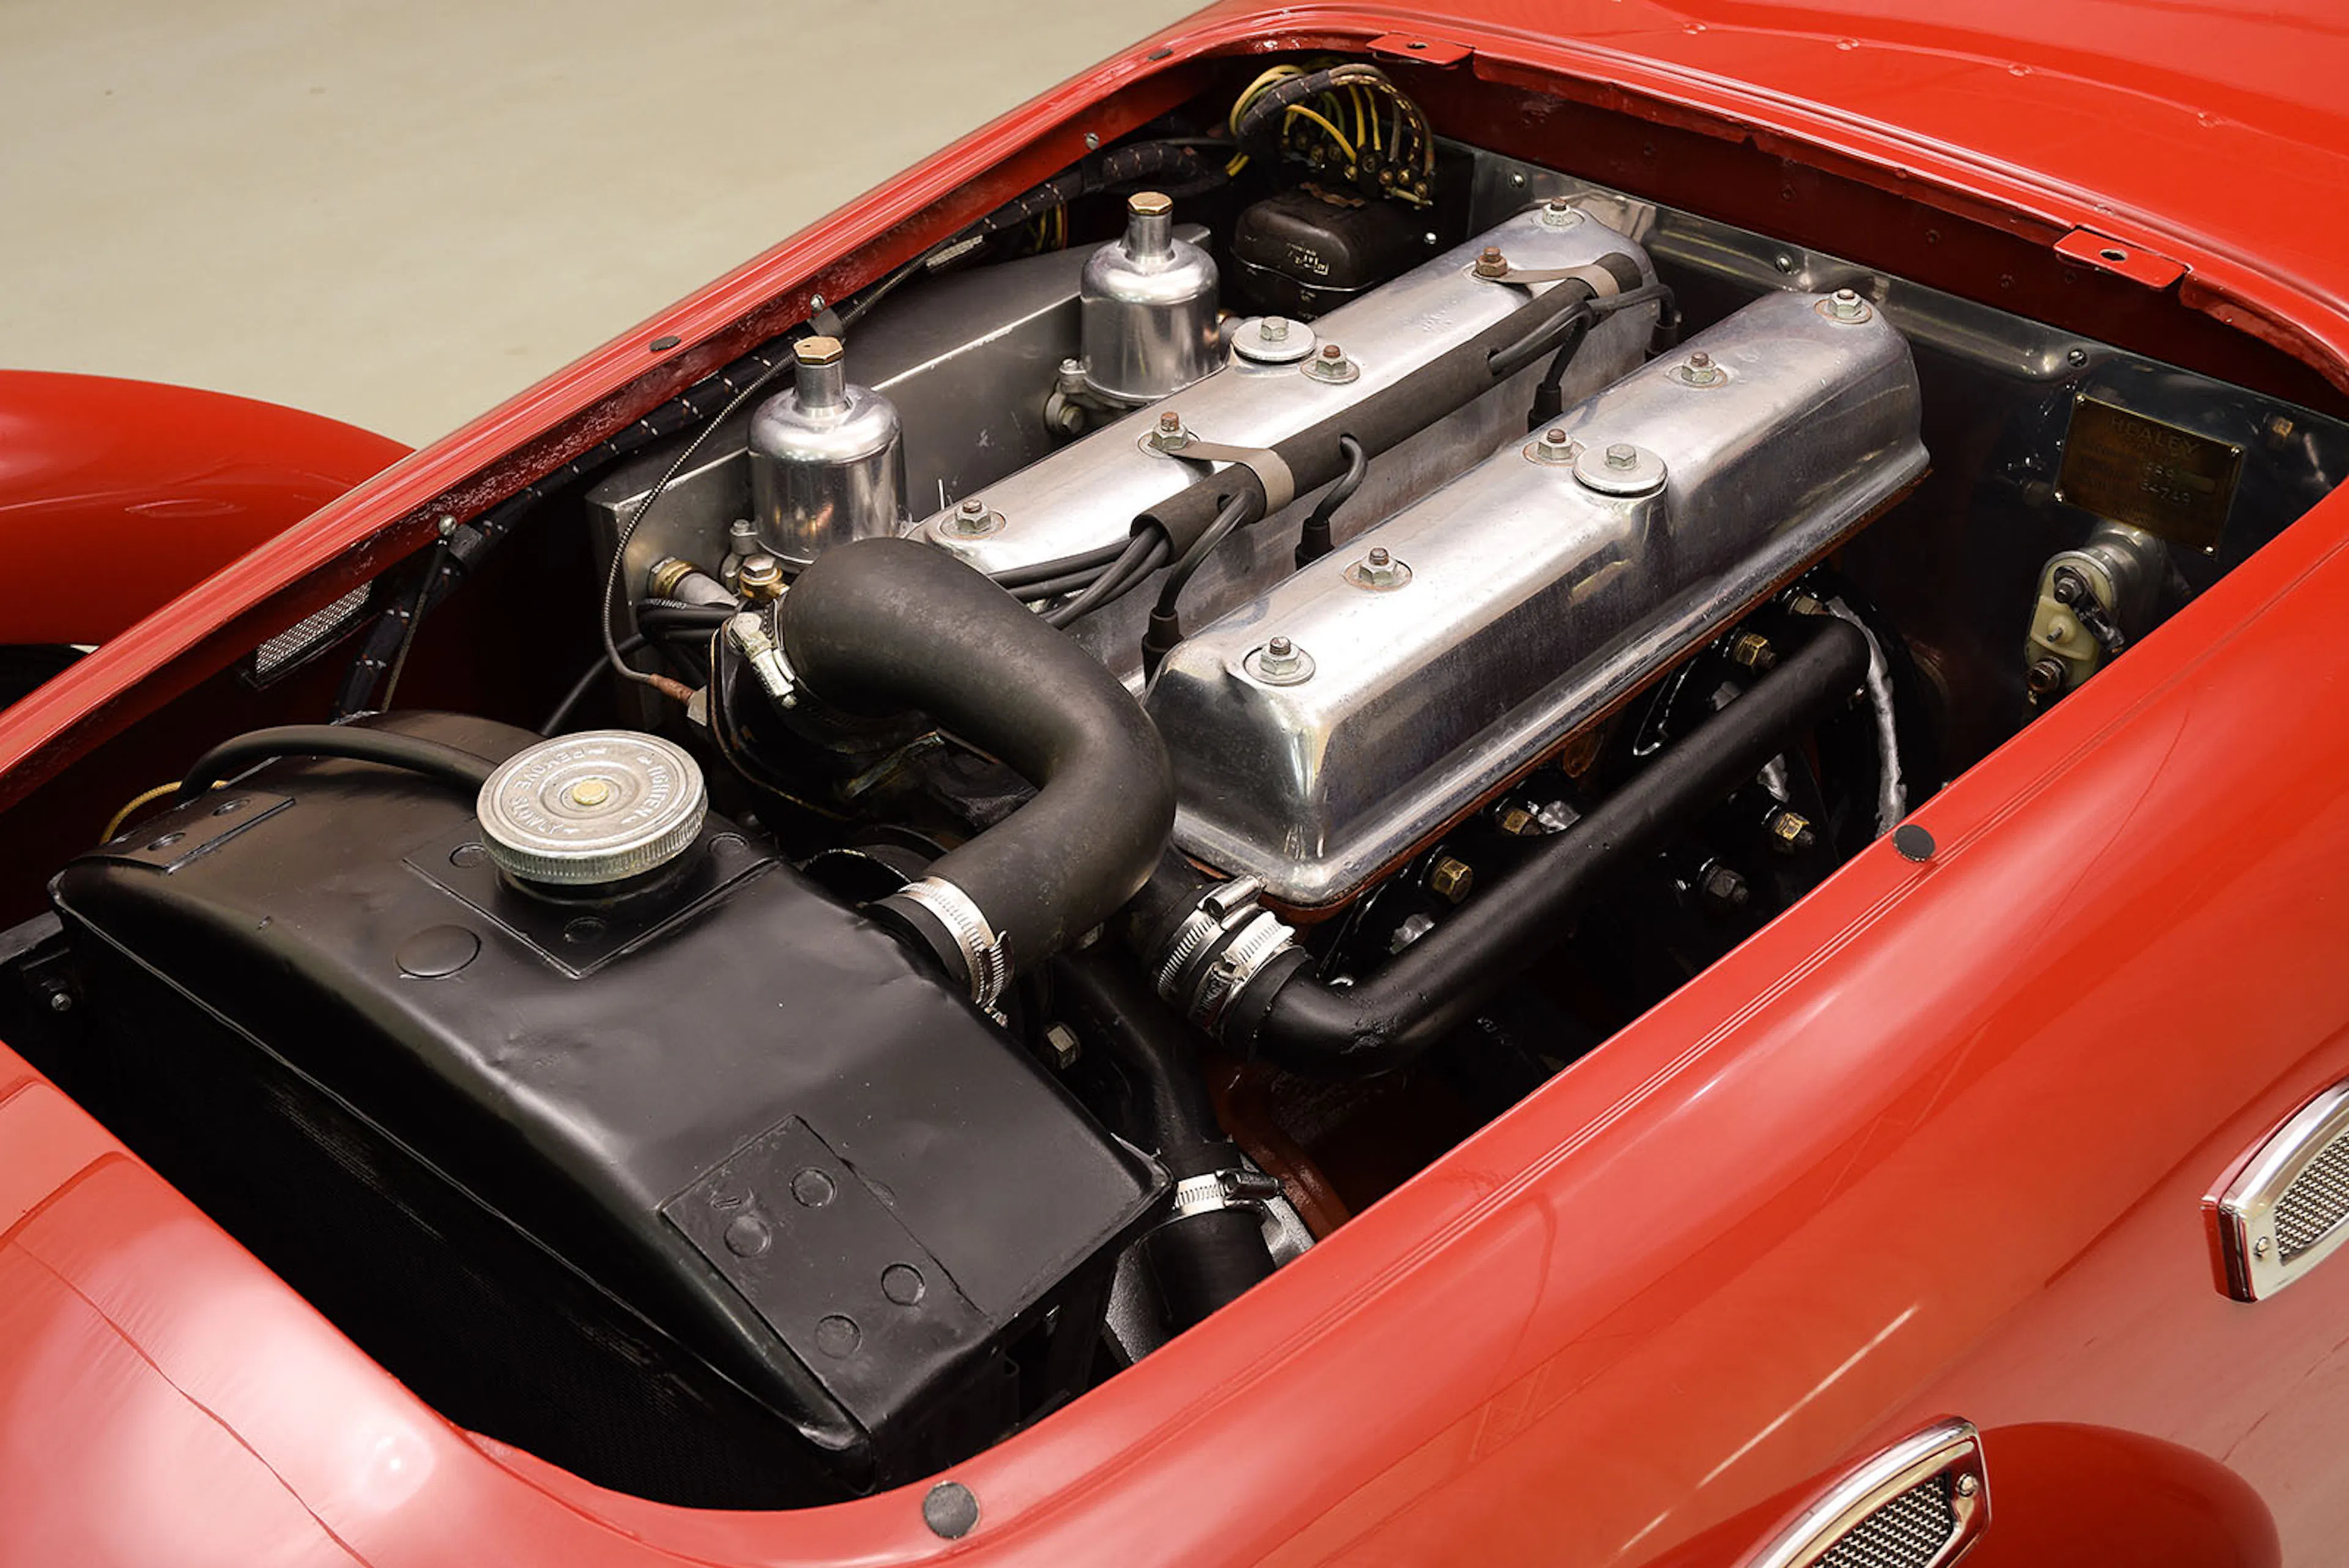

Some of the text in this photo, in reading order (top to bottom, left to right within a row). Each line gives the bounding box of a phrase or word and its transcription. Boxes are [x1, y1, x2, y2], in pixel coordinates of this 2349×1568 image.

[2111, 416, 2202, 456] HEALEY
[634, 765, 670, 817] TIGHTEN
[510, 796, 564, 834] SLOWLY
